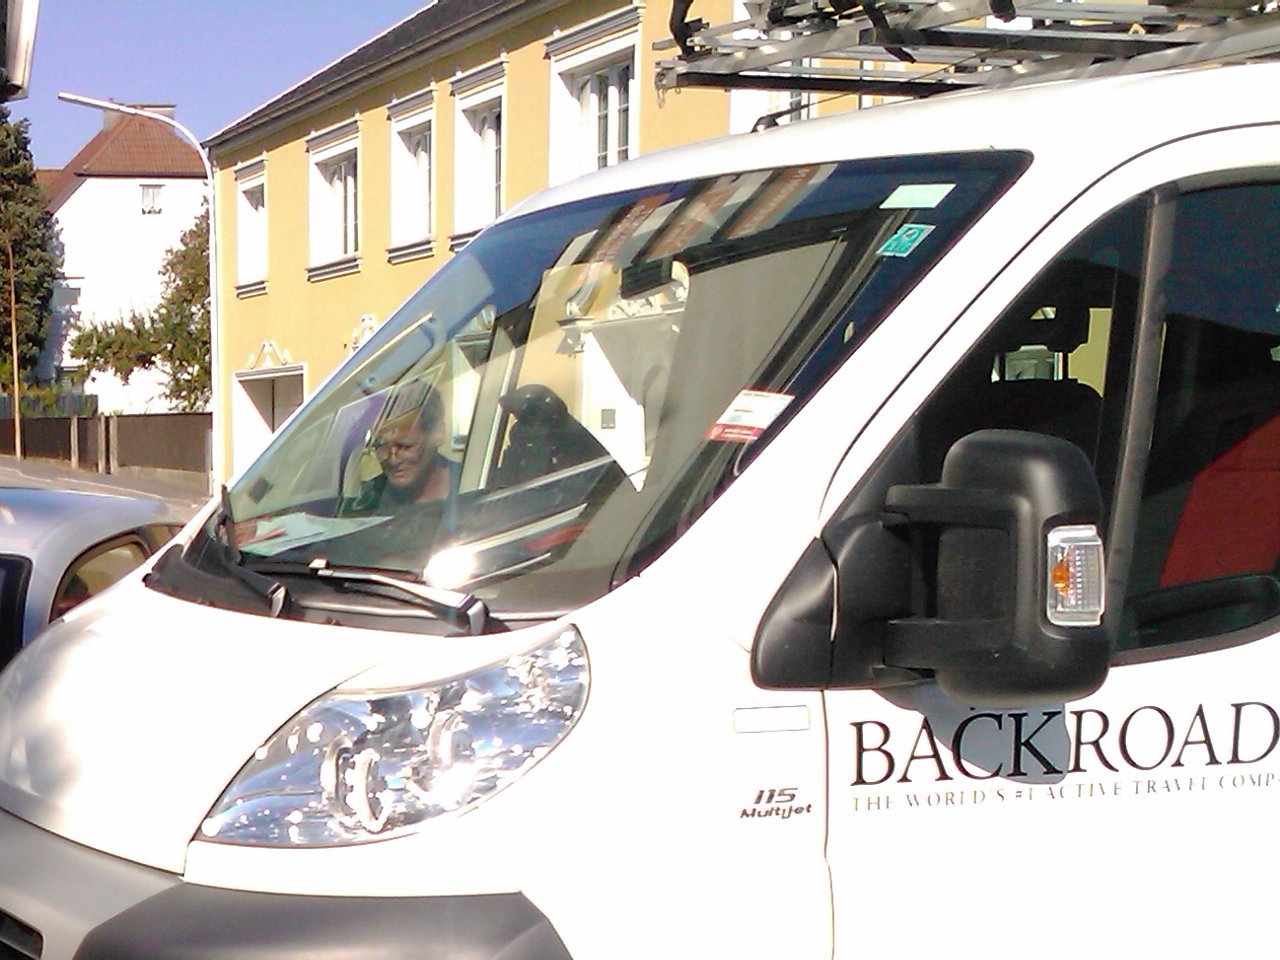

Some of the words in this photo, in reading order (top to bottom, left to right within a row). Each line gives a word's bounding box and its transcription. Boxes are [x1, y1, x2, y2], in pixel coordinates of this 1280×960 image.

[849, 700, 1280, 788] BACKROAD
[753, 786, 799, 805] 115
[851, 794, 895, 812] THE
[1046, 780, 1122, 801] ACTIVE
[1131, 773, 1207, 796] TRAVEL
[1218, 770, 1280, 790] COMP
